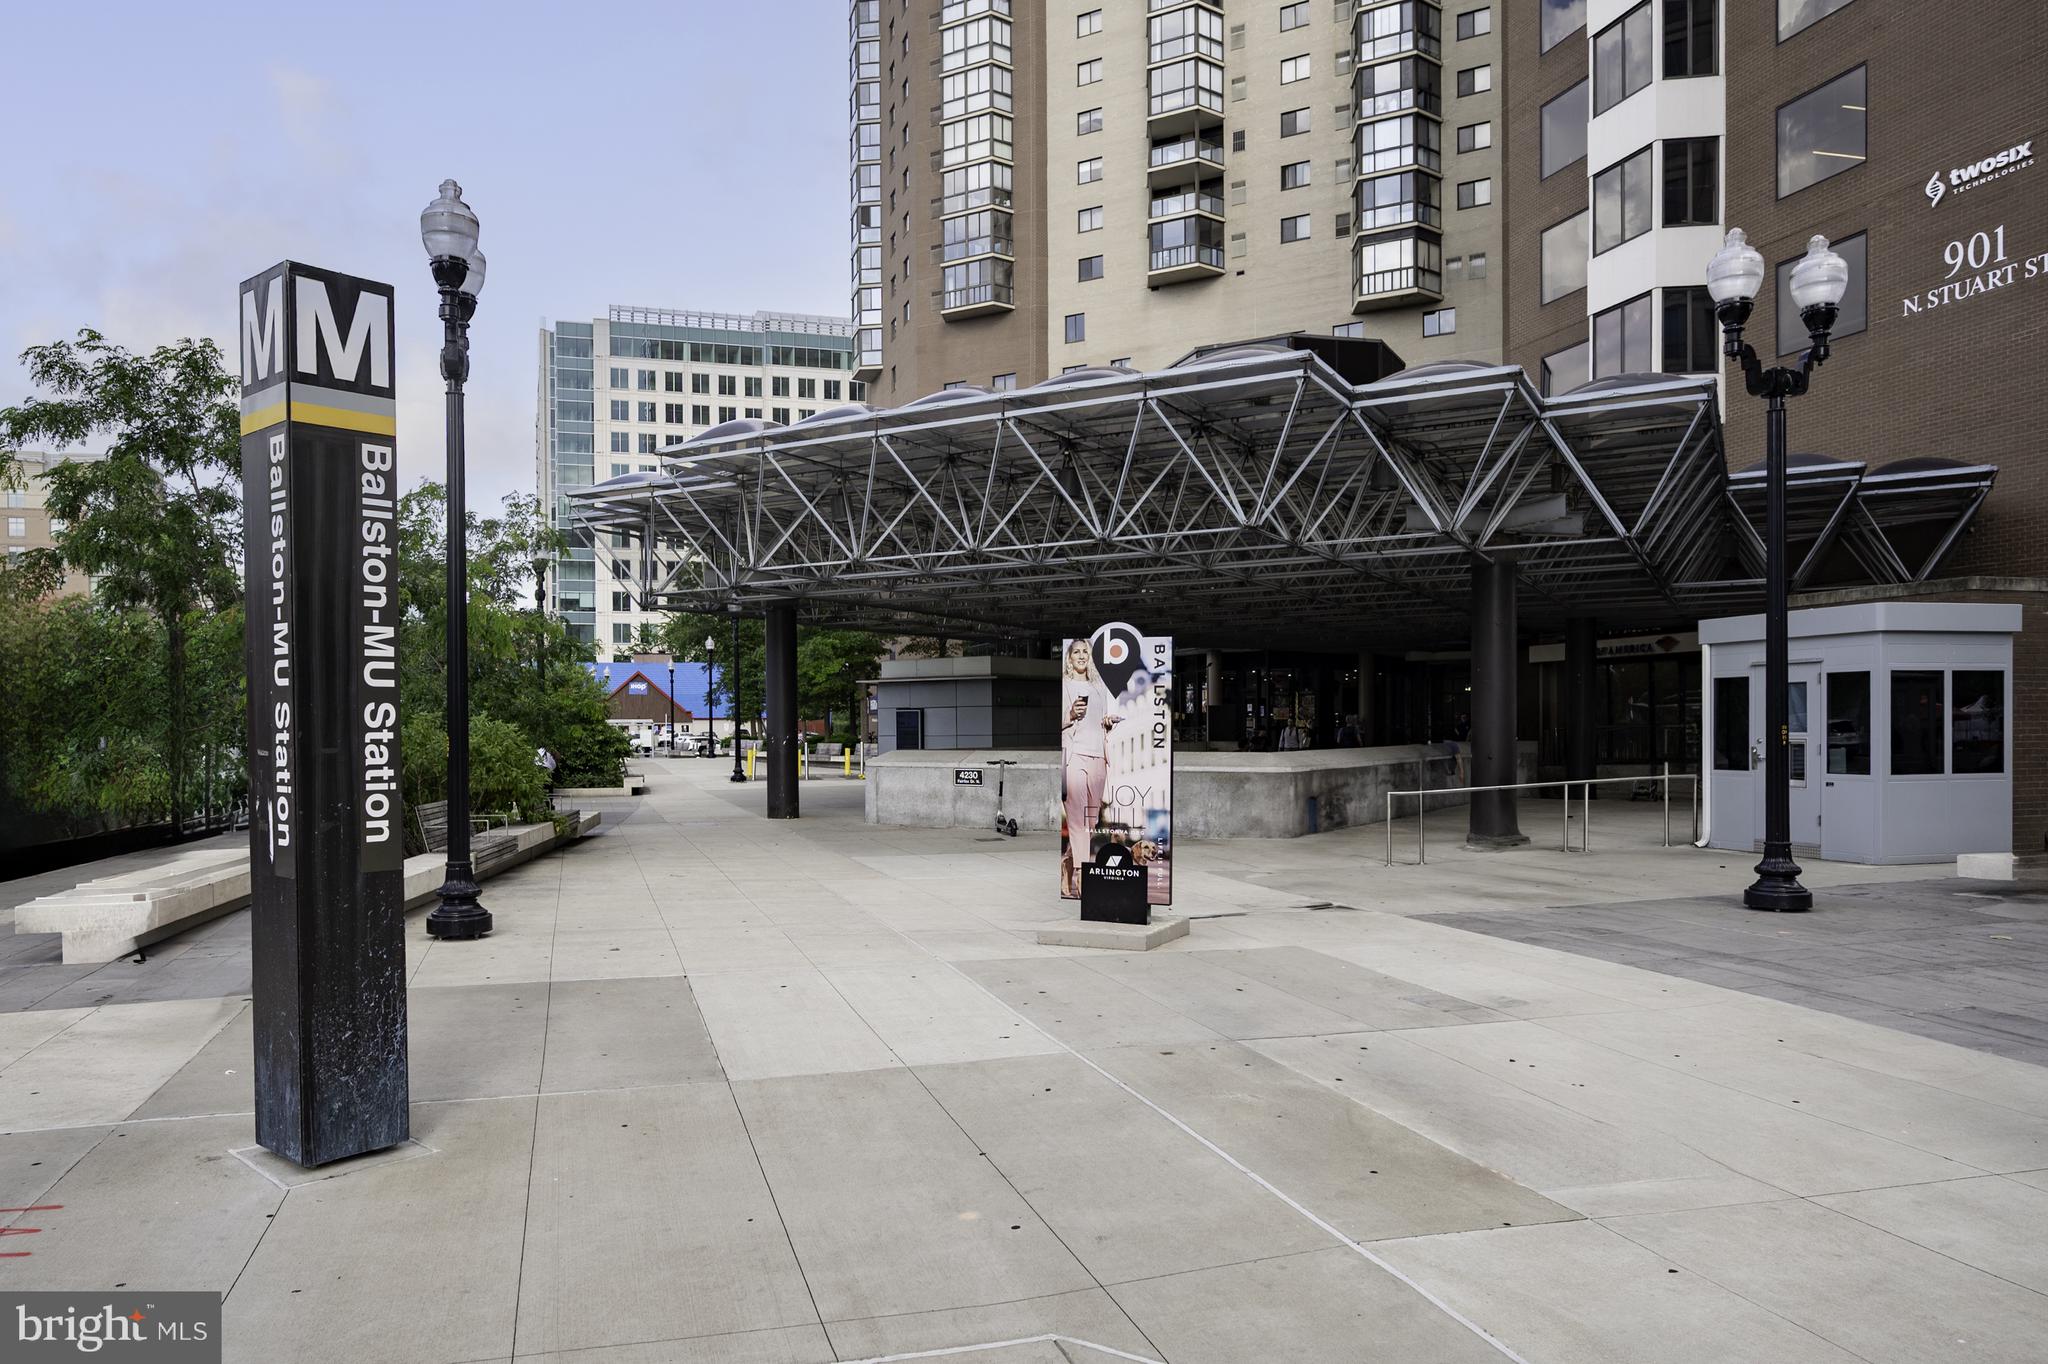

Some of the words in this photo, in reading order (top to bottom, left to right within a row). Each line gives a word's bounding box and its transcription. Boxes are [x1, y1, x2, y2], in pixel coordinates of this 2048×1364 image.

[1949, 141, 2033, 186] twosix
[1952, 158, 2035, 195] TECHNOLOGIES
[1902, 295, 1923, 317] N.
[1927, 263, 2018, 309] STUART
[1944, 224, 2008, 279] 901
[242, 275, 284, 388] M
[295, 275, 390, 388] M
[269, 433, 290, 687] Ballston-MU
[361, 443, 396, 688] Ballston-MU
[1153, 644, 1166, 749] BALLSTON
[274, 701, 292, 847] Station
[363, 702, 397, 843] Station
[1104, 785, 1152, 806] JOY
[1089, 867, 1140, 877] ARLINGTON
